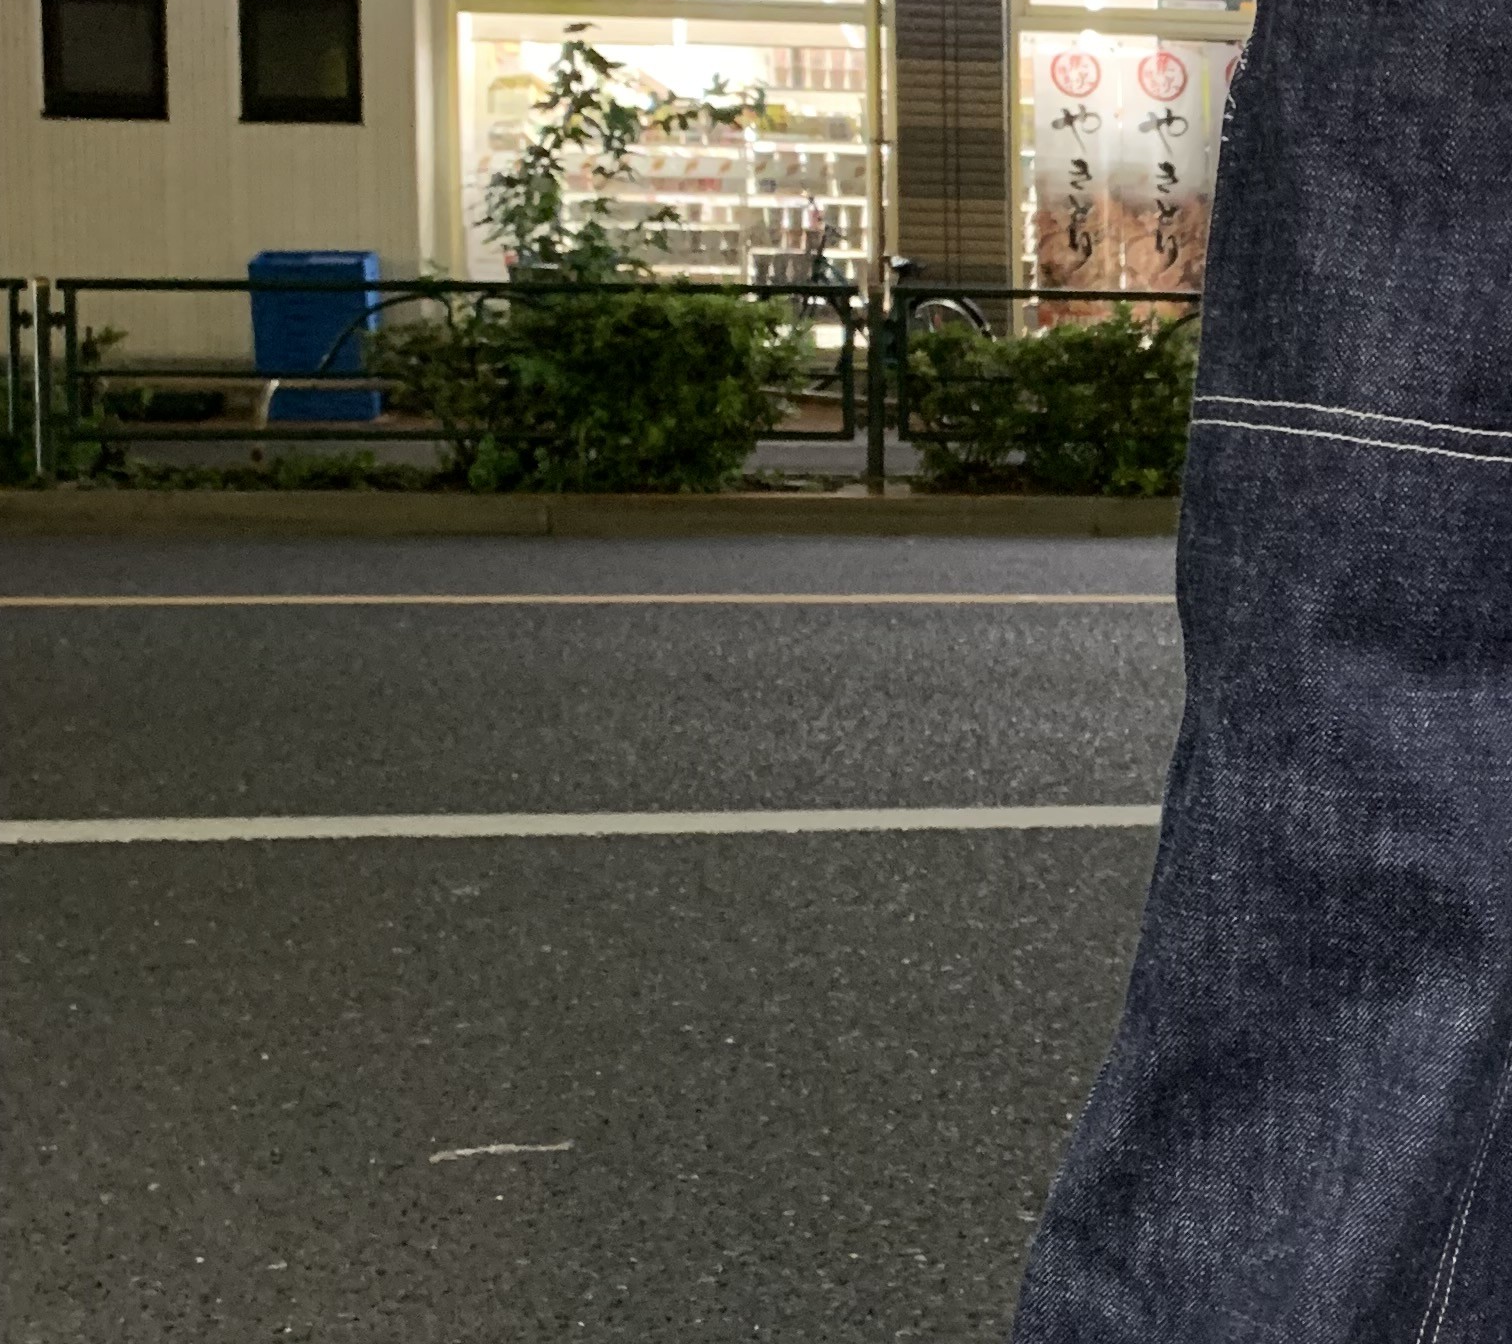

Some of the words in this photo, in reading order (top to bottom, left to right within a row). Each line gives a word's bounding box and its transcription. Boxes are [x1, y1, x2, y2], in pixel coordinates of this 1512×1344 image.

[1051, 104, 1102, 270] やきとり
[1138, 107, 1189, 269] やきとり
